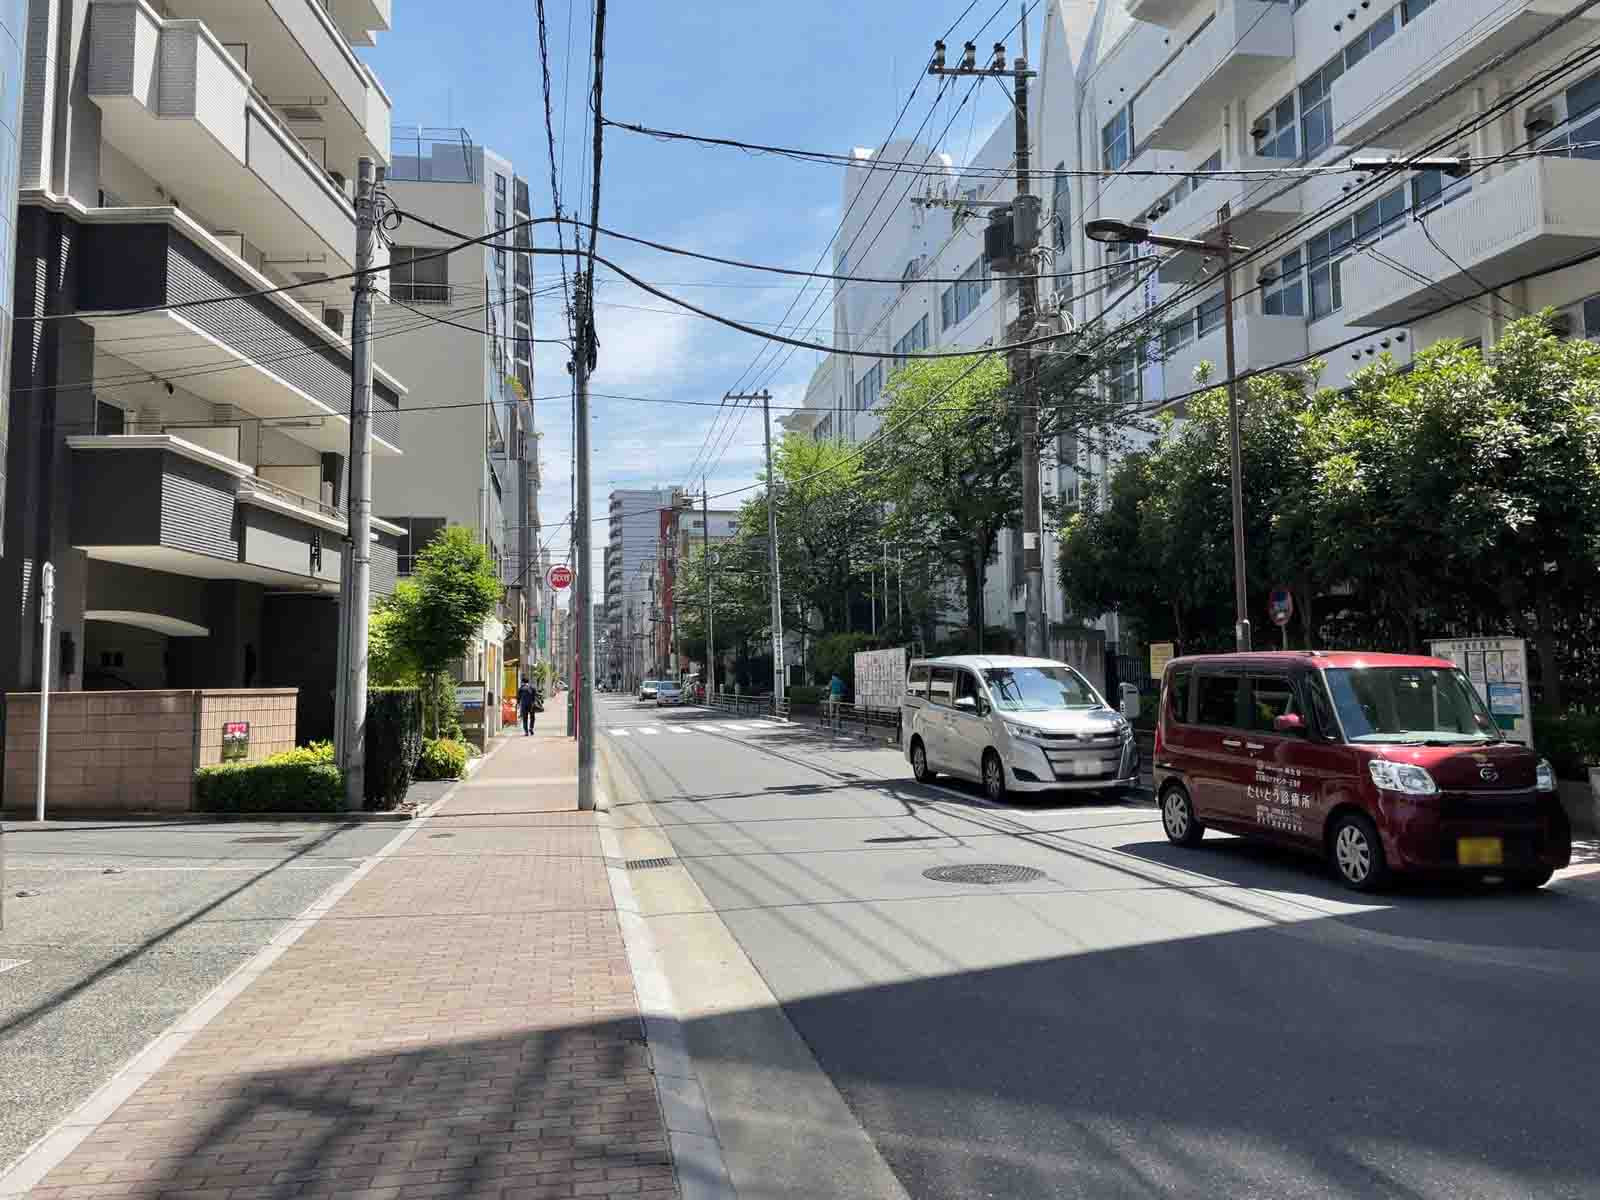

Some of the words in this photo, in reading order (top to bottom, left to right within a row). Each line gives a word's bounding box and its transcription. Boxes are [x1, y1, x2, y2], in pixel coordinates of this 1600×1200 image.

[1247, 784, 1312, 809] たいとう診療所
